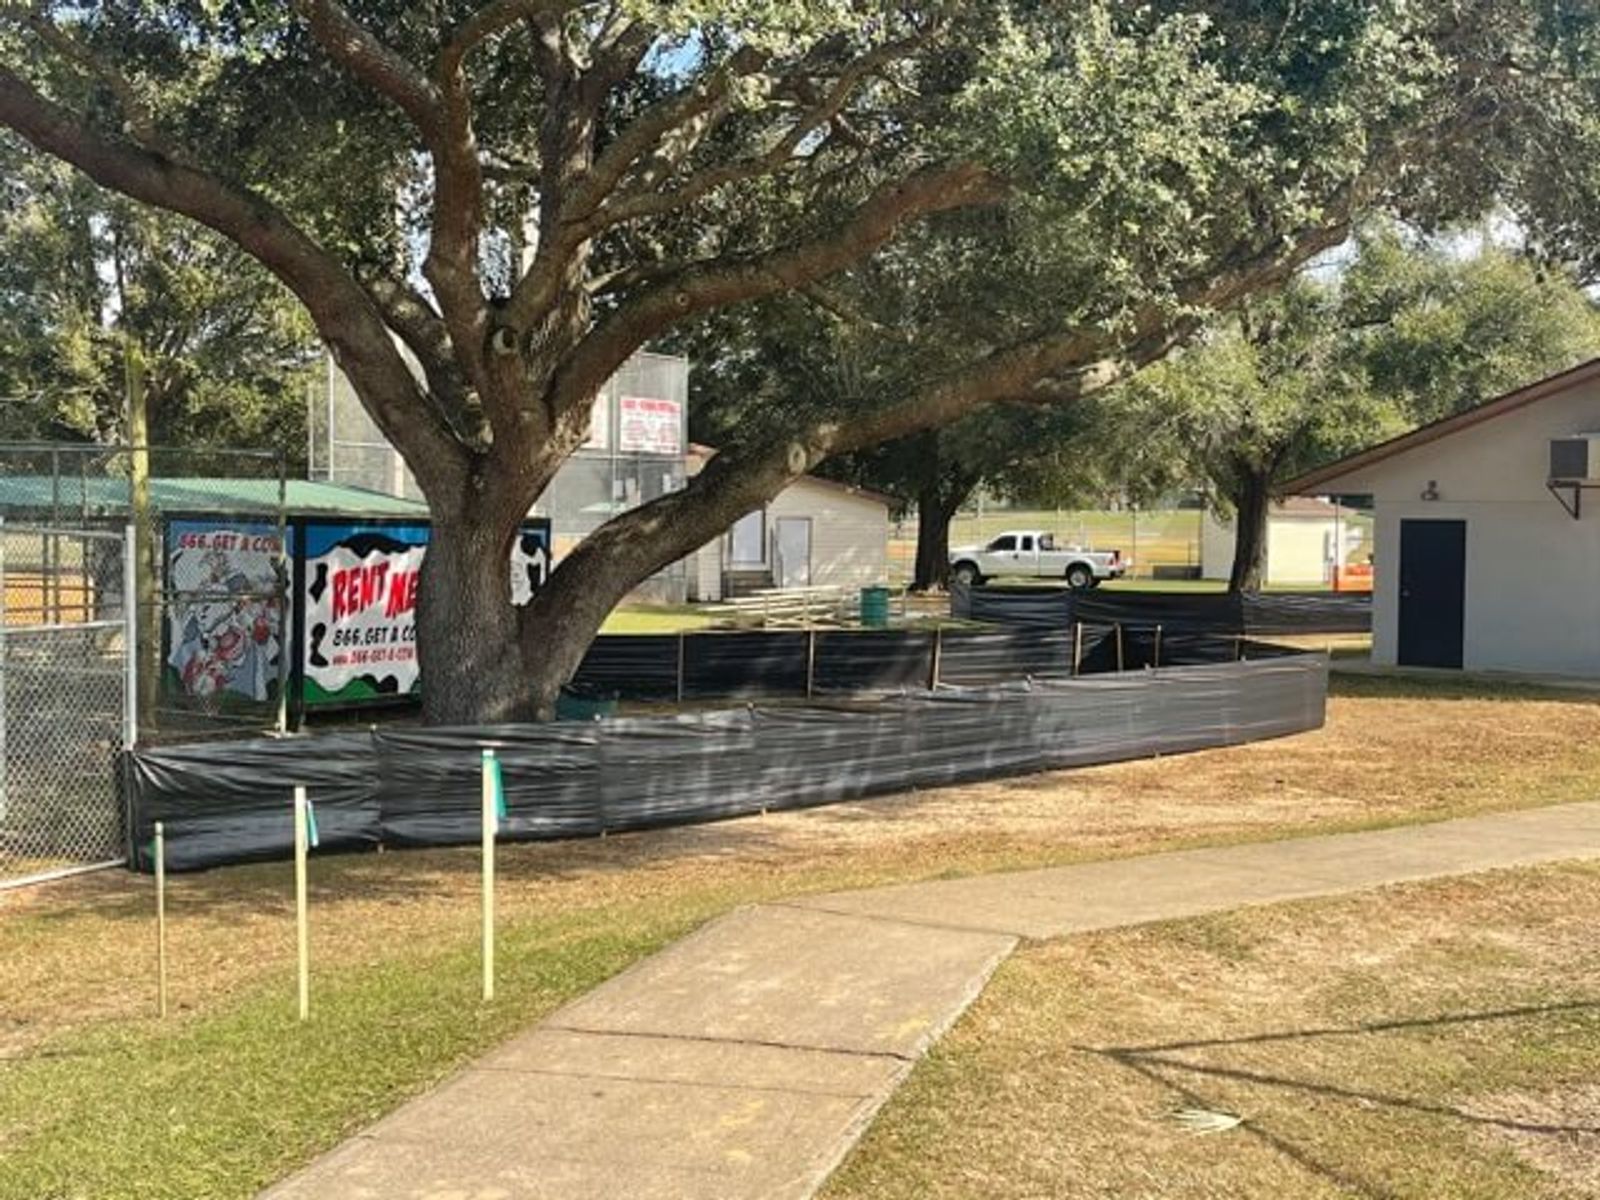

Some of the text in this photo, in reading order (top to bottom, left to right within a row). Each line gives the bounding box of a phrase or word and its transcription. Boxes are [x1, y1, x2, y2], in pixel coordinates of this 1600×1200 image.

[332, 560, 418, 624] RENT ME
[333, 626, 388, 646] 866.GET
[390, 625, 399, 643] A
